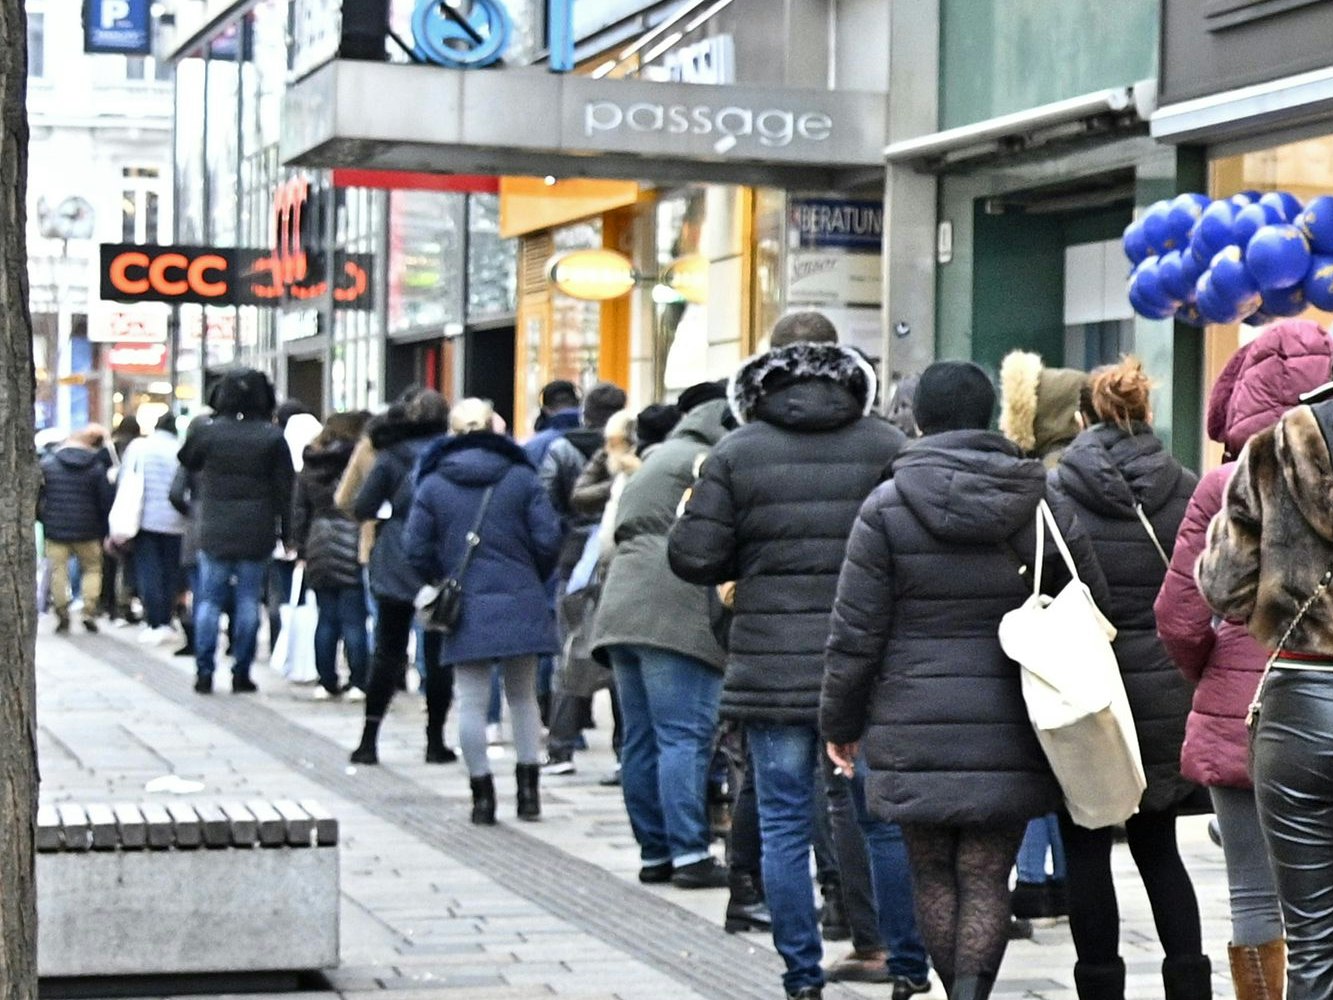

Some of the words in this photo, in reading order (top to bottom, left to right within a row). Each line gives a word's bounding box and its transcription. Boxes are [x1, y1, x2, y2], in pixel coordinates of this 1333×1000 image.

[101, 0, 130, 29] P
[584, 101, 833, 148] passage
[109, 251, 228, 297] CCC
